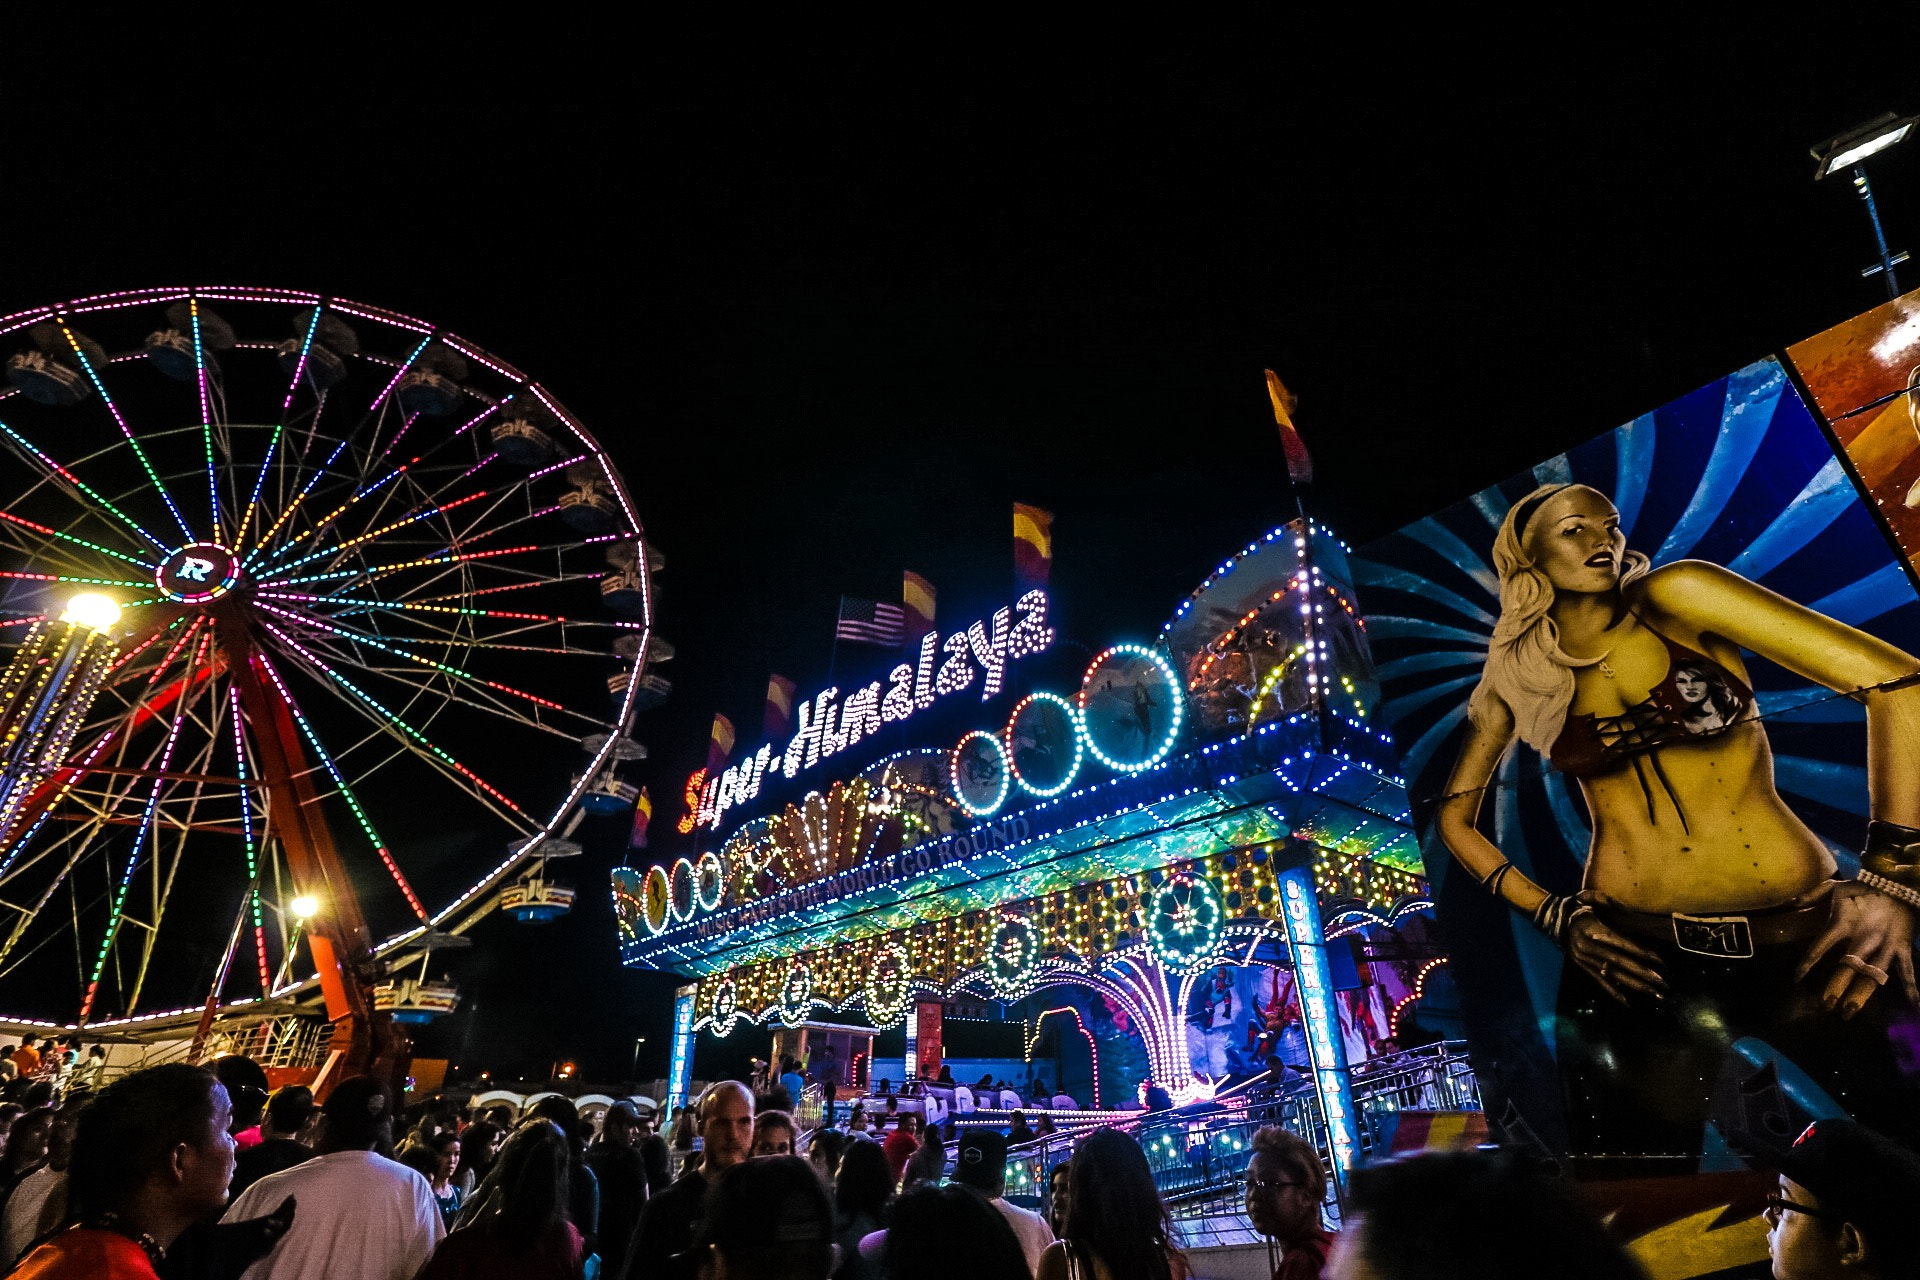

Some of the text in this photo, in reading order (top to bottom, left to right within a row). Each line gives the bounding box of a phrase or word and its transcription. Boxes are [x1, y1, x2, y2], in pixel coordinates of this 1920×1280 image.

[698, 914, 735, 938] MUSIC
[790, 884, 823, 908] THE
[826, 861, 895, 897] WORLD
[901, 850, 931, 875] GO
[938, 817, 1030, 862] ROUND
[1286, 880, 1319, 988] SUPER
